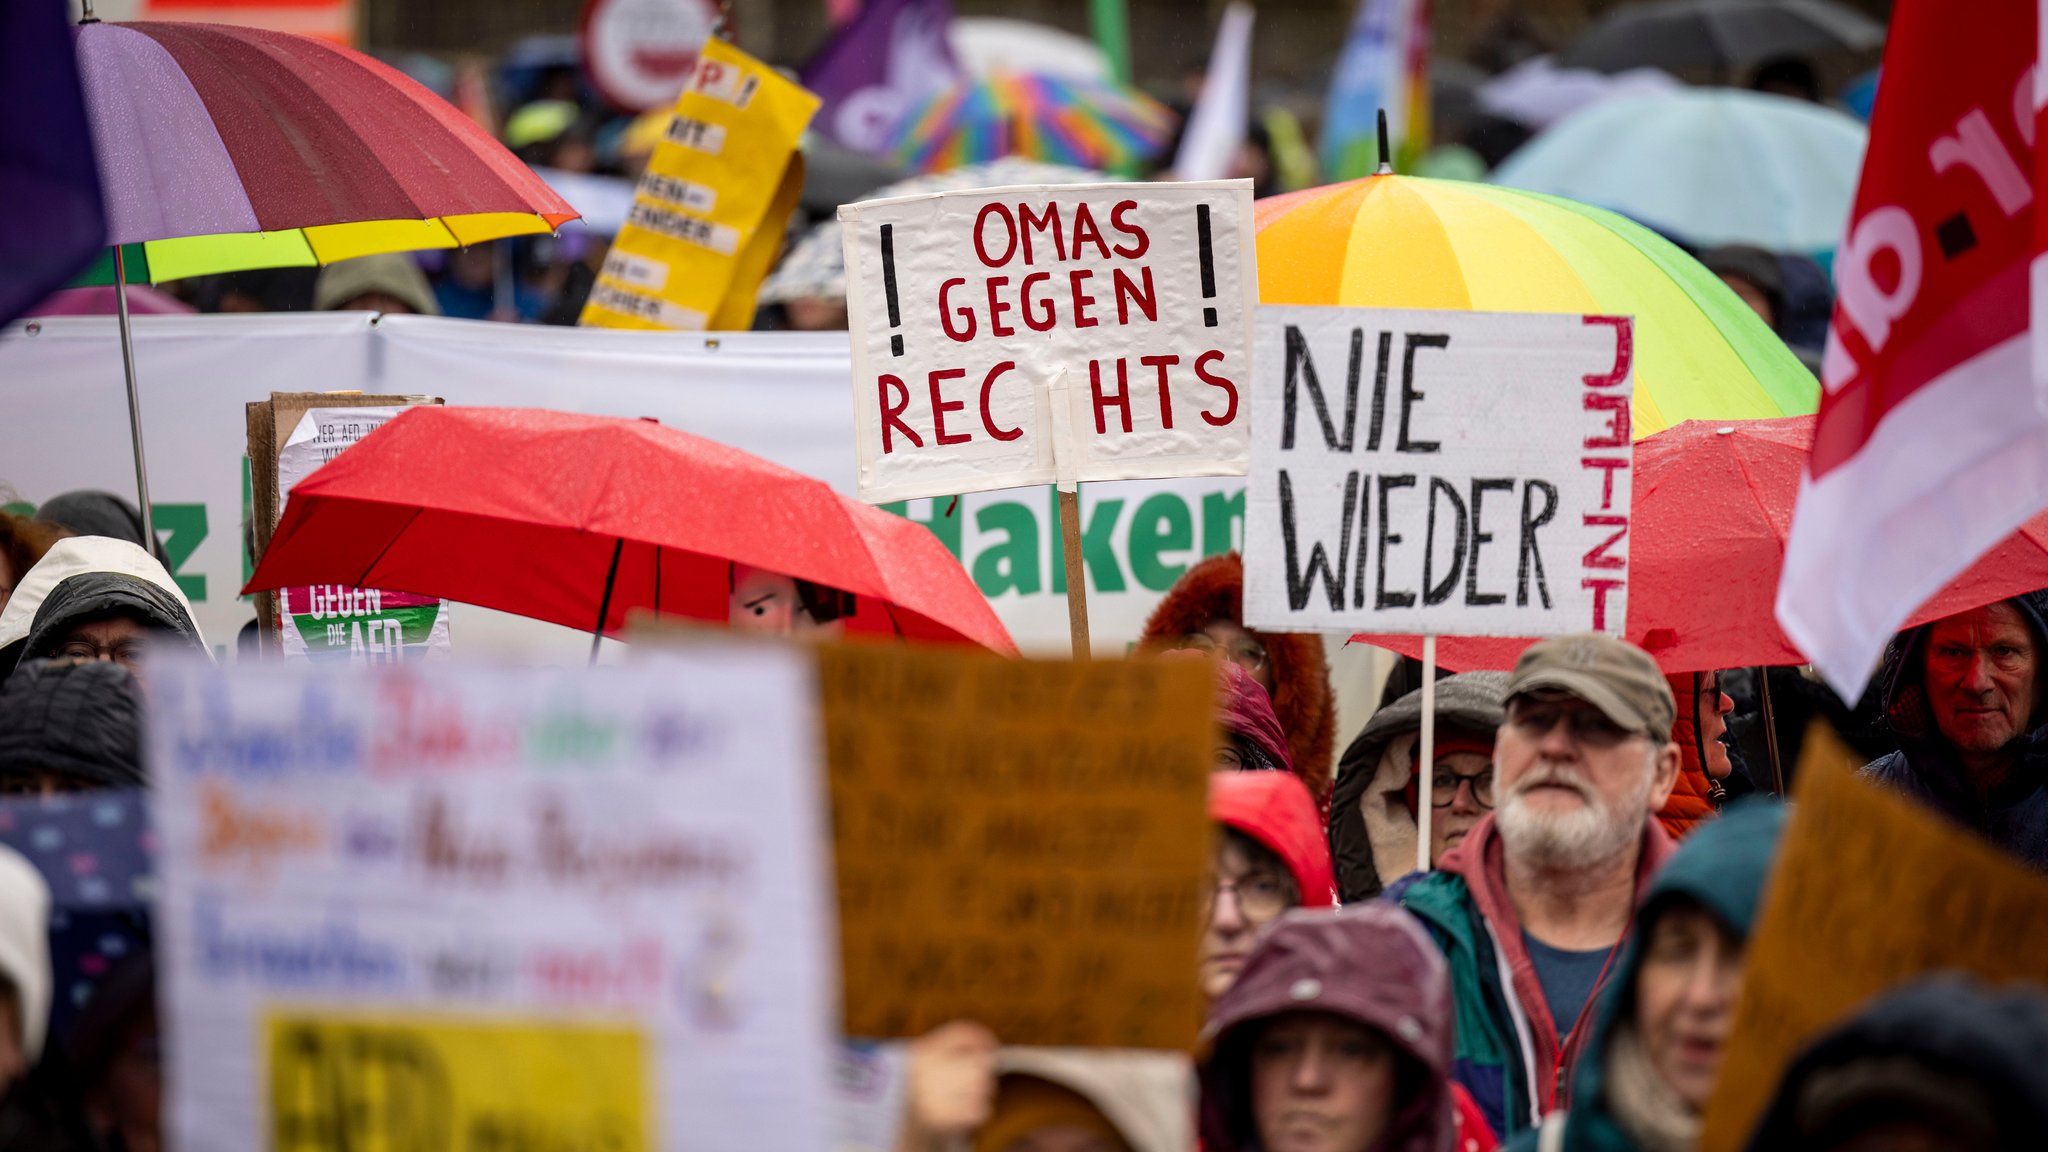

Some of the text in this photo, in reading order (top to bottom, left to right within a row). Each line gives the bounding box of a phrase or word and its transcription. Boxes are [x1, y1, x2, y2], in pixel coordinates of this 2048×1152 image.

[973, 199, 1150, 268] OMAS
[938, 266, 1158, 343] GEGEN
[1281, 324, 1450, 453] NIE
[341, 423, 360, 442] AFD
[1580, 314, 1634, 632] JETZT
[1278, 469, 1560, 612] WIEDER
[309, 584, 382, 620] GEGEN
[327, 623, 346, 646] DIE
